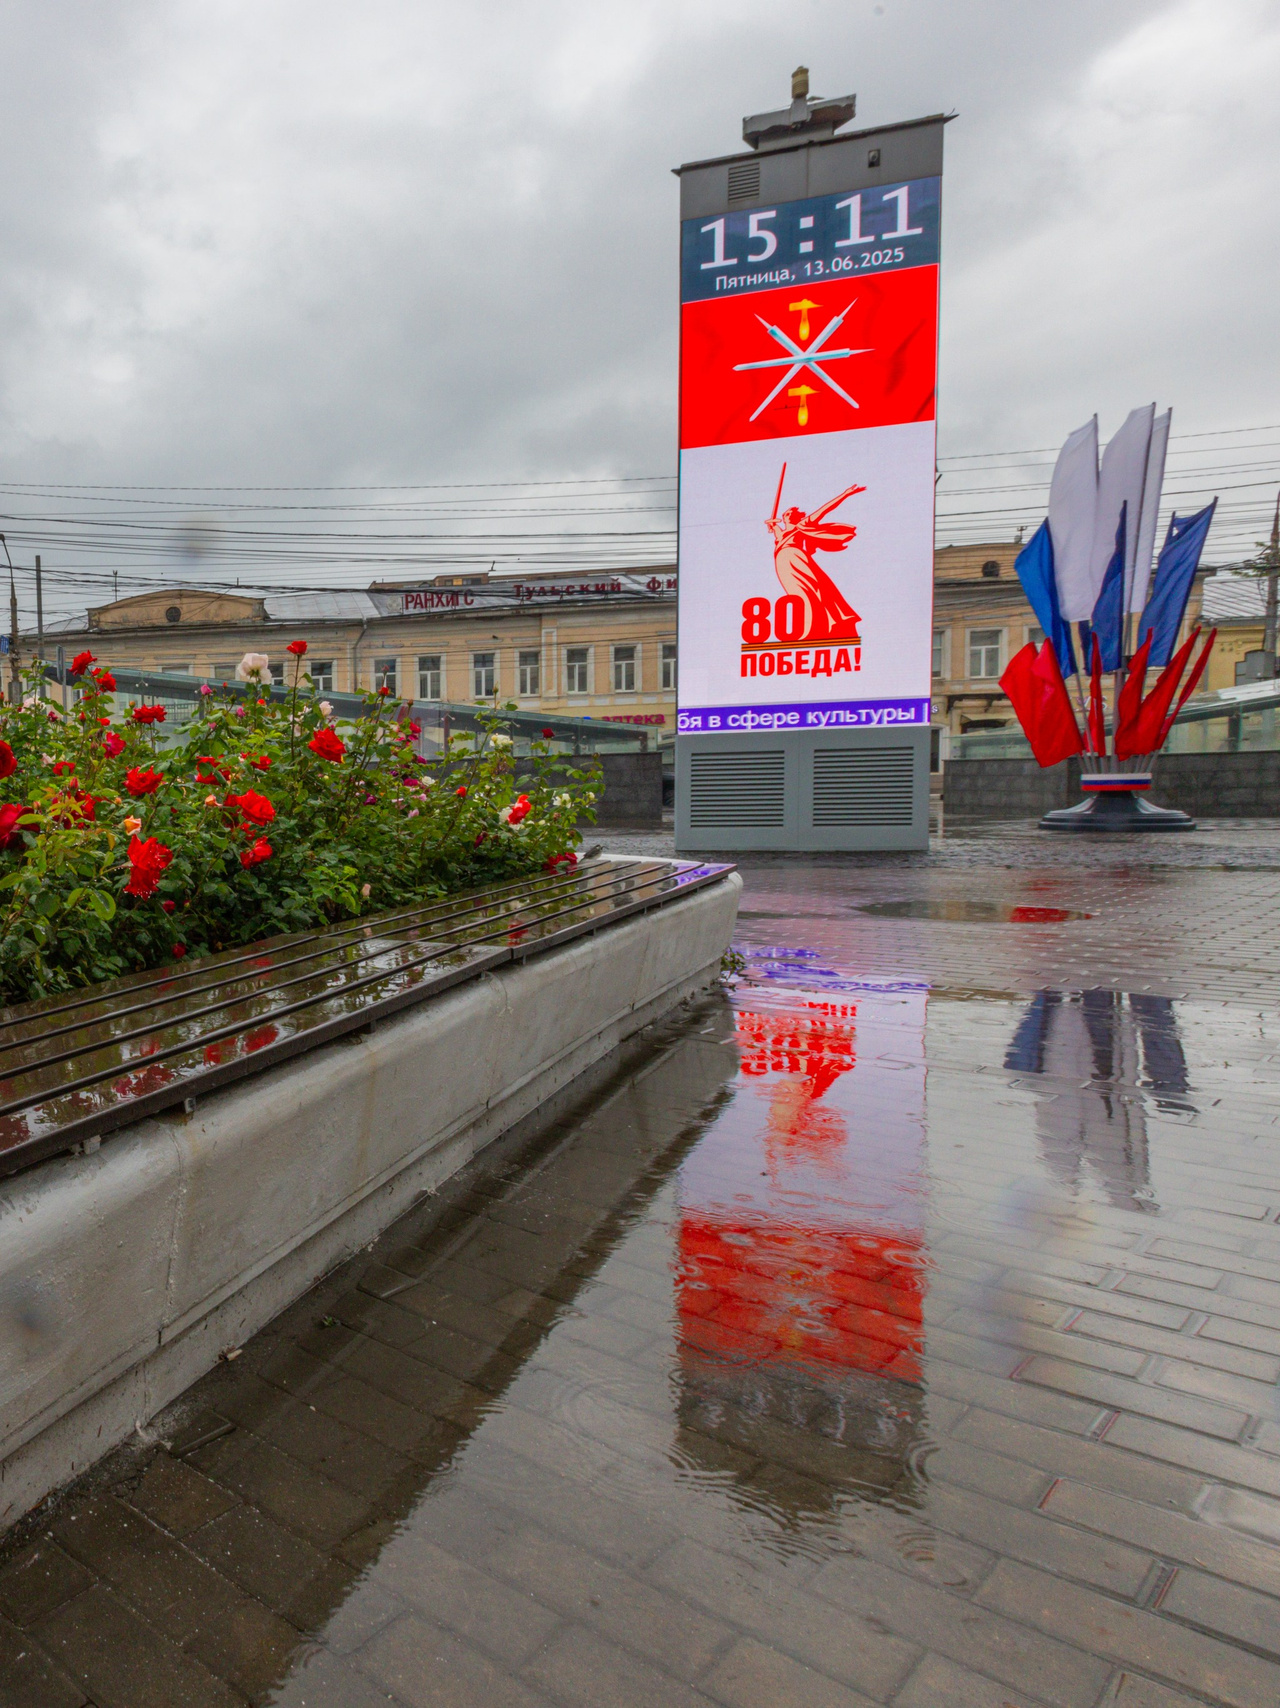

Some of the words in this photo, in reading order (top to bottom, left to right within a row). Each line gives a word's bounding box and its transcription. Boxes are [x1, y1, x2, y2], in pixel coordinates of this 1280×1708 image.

[700, 184, 923, 270] 15:11
[715, 268, 796, 291] Пятница,
[803, 247, 905, 277] 13.06.2025
[740, 594, 808, 644] 80
[740, 647, 862, 678] ПОБЕДА!
[708, 714, 721, 728] в
[726, 710, 800, 730] сфере
[806, 707, 915, 726] культуры
